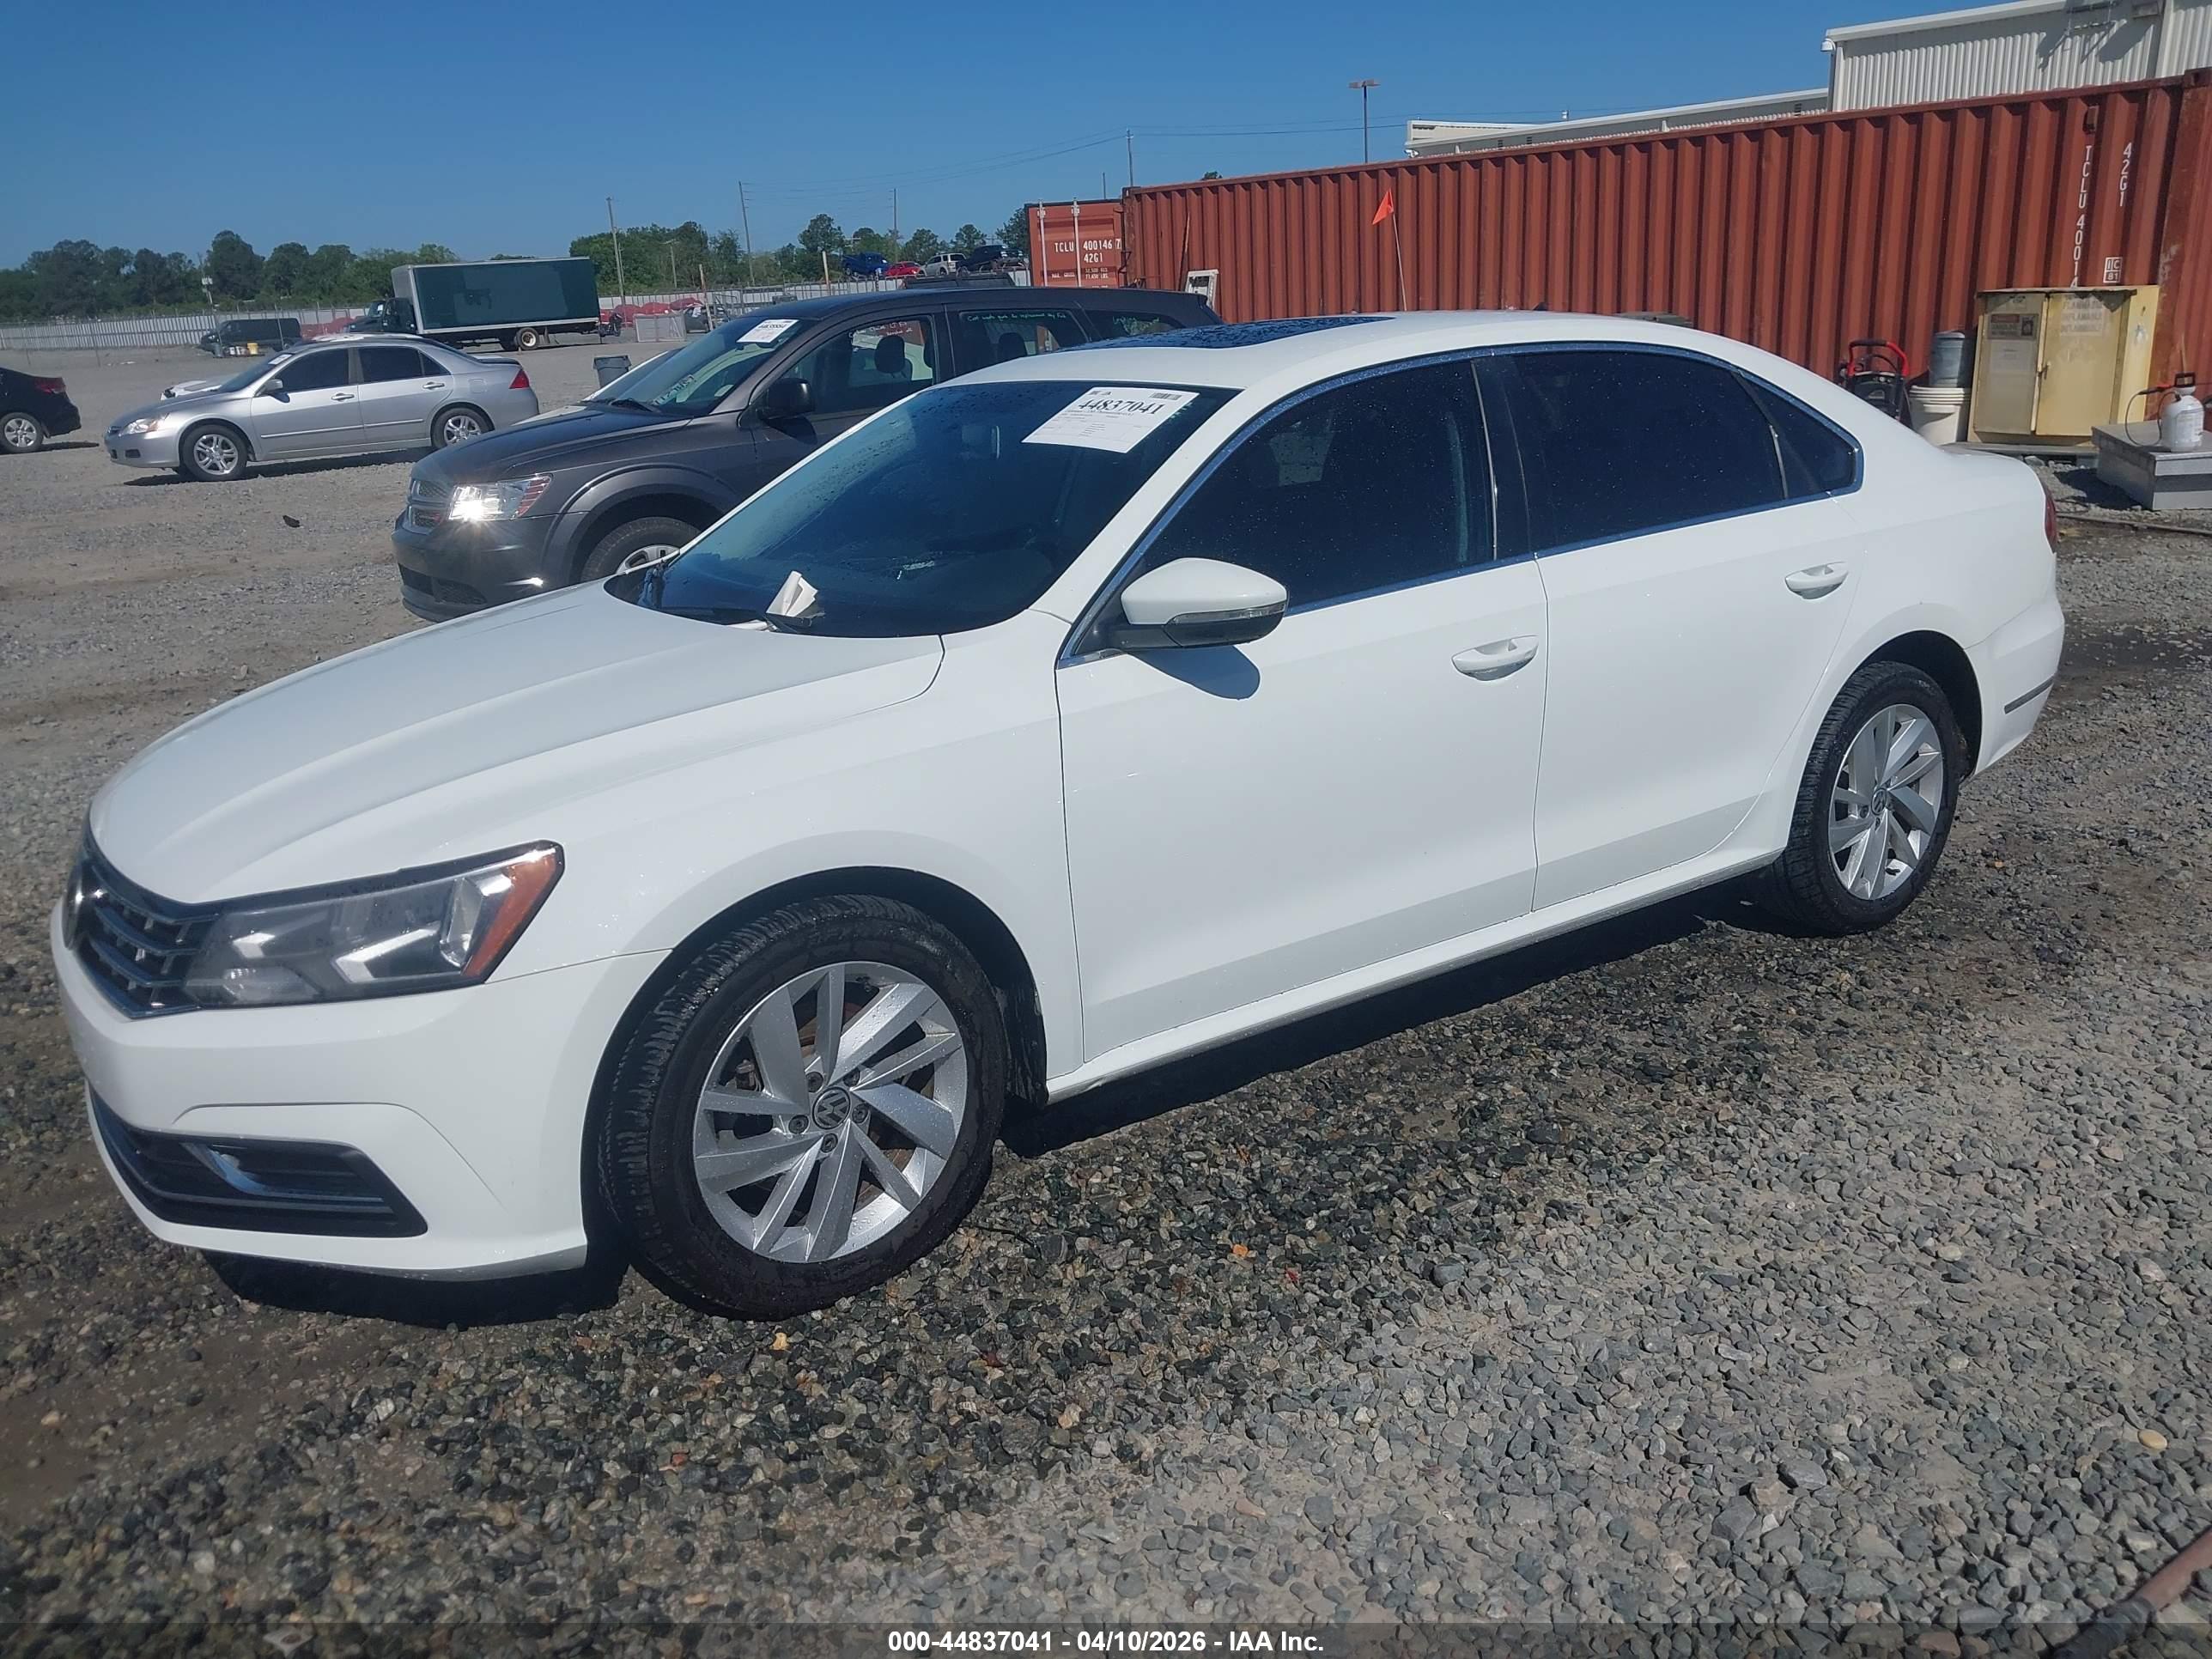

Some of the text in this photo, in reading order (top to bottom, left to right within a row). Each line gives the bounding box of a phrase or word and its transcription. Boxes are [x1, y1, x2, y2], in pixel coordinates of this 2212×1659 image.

[2077, 145, 2093, 209] TCLU
[2119, 142, 2132, 207] 42G1
[1054, 241, 1074, 252] TCLU
[1083, 240, 1113, 251] 400146
[1084, 252, 1103, 264] 42G1
[1078, 398, 1167, 415] 44837041
